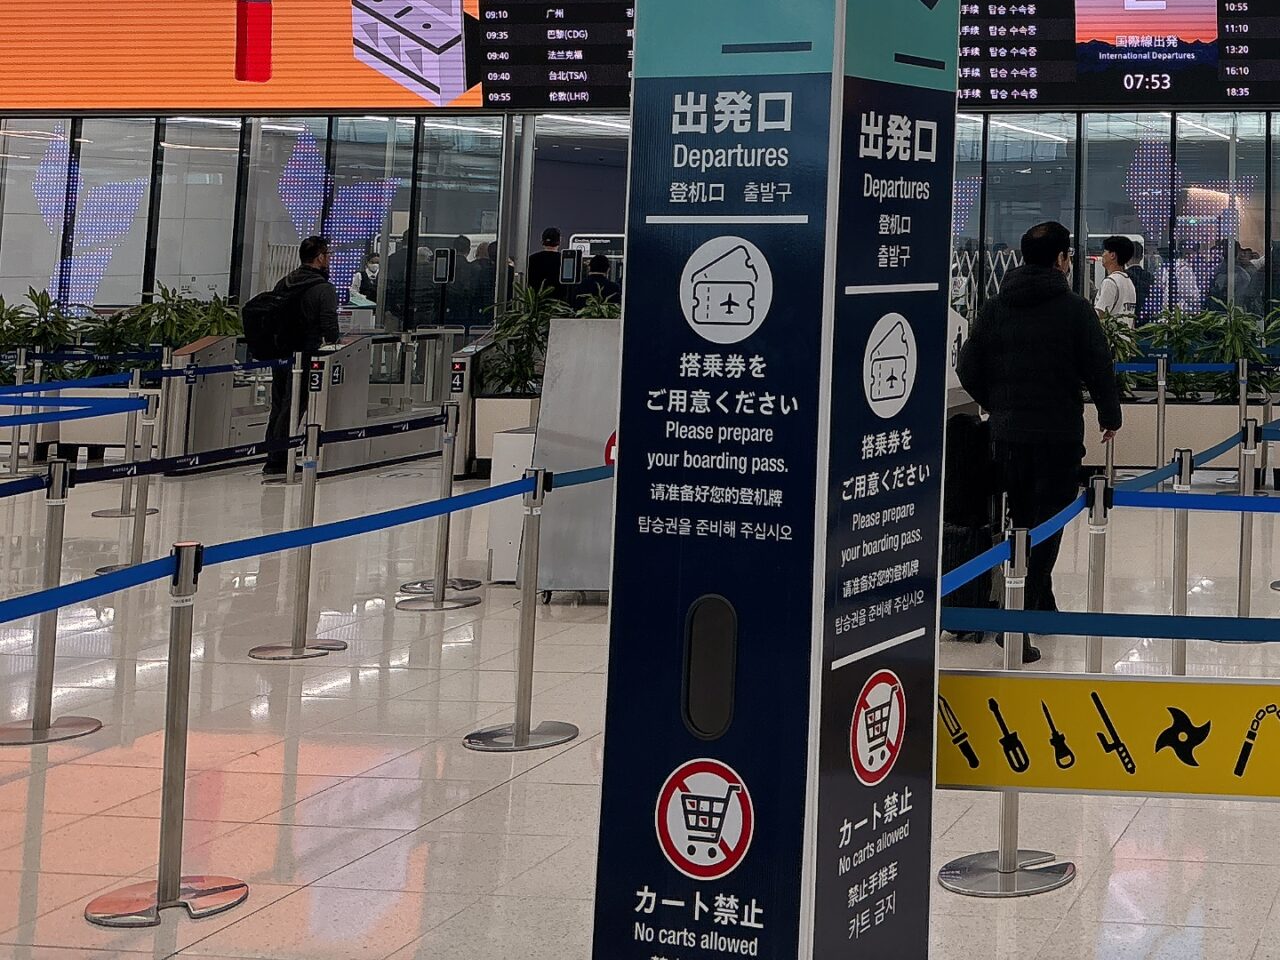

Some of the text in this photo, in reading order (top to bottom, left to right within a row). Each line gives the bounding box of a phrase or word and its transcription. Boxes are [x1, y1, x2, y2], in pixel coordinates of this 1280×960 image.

[486, 10, 508, 19] 09:10
[546, 9, 564, 19] 广州
[1225, 2, 1248, 12] 10:55
[486, 32, 508, 40] 09:35
[1225, 24, 1248, 32] 11:10
[1115, 35, 1178, 48] 国際線出発
[1226, 45, 1248, 54] 13:20
[487, 52, 510, 60] 09:40
[1099, 52, 1195, 61] International Departures
[488, 73, 510, 81] 09:40
[549, 71, 587, 82] 台北(TSA)
[1124, 74, 1171, 90] 07:53
[1226, 66, 1249, 75] 16:10
[488, 93, 510, 101] 09:55
[1226, 88, 1250, 96] 18:35
[672, 90, 792, 134] 出発口
[858, 111, 938, 162] 出発口
[674, 144, 788, 172] Departures
[670, 182, 724, 203] 登机口
[744, 182, 792, 202] 출발구
[864, 173, 930, 202] Departures
[878, 214, 911, 235] 登机口
[878, 244, 911, 268] 출발구
[333, 367, 340, 378] 4
[680, 352, 766, 378] 搭乗券を
[311, 374, 320, 386] 3
[452, 374, 462, 386] 4
[647, 388, 798, 415] ご用意ください
[666, 421, 773, 444] Please prepare
[861, 428, 912, 460] 搭乗券を
[648, 450, 788, 474] your boarding pass.
[842, 464, 930, 500] ご用意ください
[650, 483, 782, 507] 请准备好您的登机牌
[638, 516, 792, 541] 탑승권을 준비해 주십시오
[852, 503, 914, 531] Please prepare
[841, 528, 922, 568] your boarding pass.
[842, 559, 919, 598] 请准备好您的登机牌
[835, 590, 924, 635] 탑승권을 준비해 주십시오
[838, 786, 912, 848] カート禁止
[838, 819, 910, 876] No carts allowed
[848, 861, 898, 908] 禁止手推车
[634, 886, 764, 928] カート禁止
[849, 891, 896, 940] 카트 금지
[634, 922, 758, 956] No carts allowed
